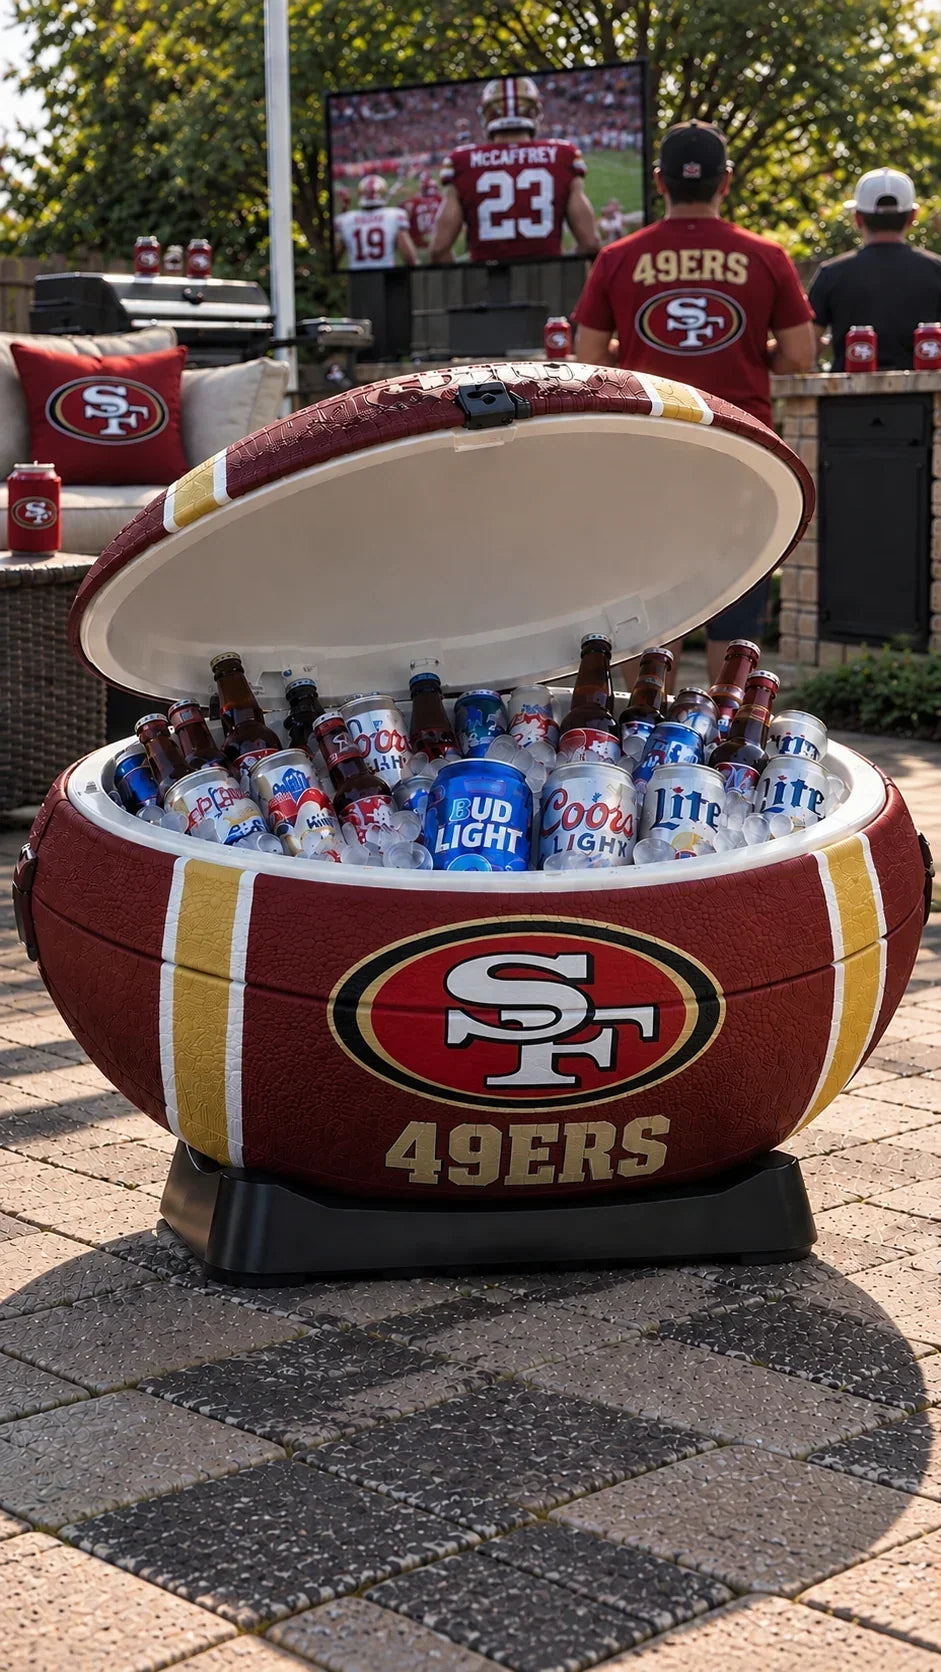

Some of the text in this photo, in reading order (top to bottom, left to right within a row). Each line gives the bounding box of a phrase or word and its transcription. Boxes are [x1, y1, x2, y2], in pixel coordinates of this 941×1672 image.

[470, 147, 557, 168] McCAFFREY
[476, 168, 554, 241] 23
[353, 227, 385, 261] 19
[632, 249, 750, 286] 49ERS
[666, 297, 725, 348] SF
[81, 384, 150, 437] SF
[449, 796, 513, 824] BUD
[541, 787, 635, 840] Coors
[649, 786, 722, 833] Lite
[434, 822, 523, 854] LIGHT
[444, 951, 661, 1090] SF
[385, 1114, 671, 1187] 49ERS
